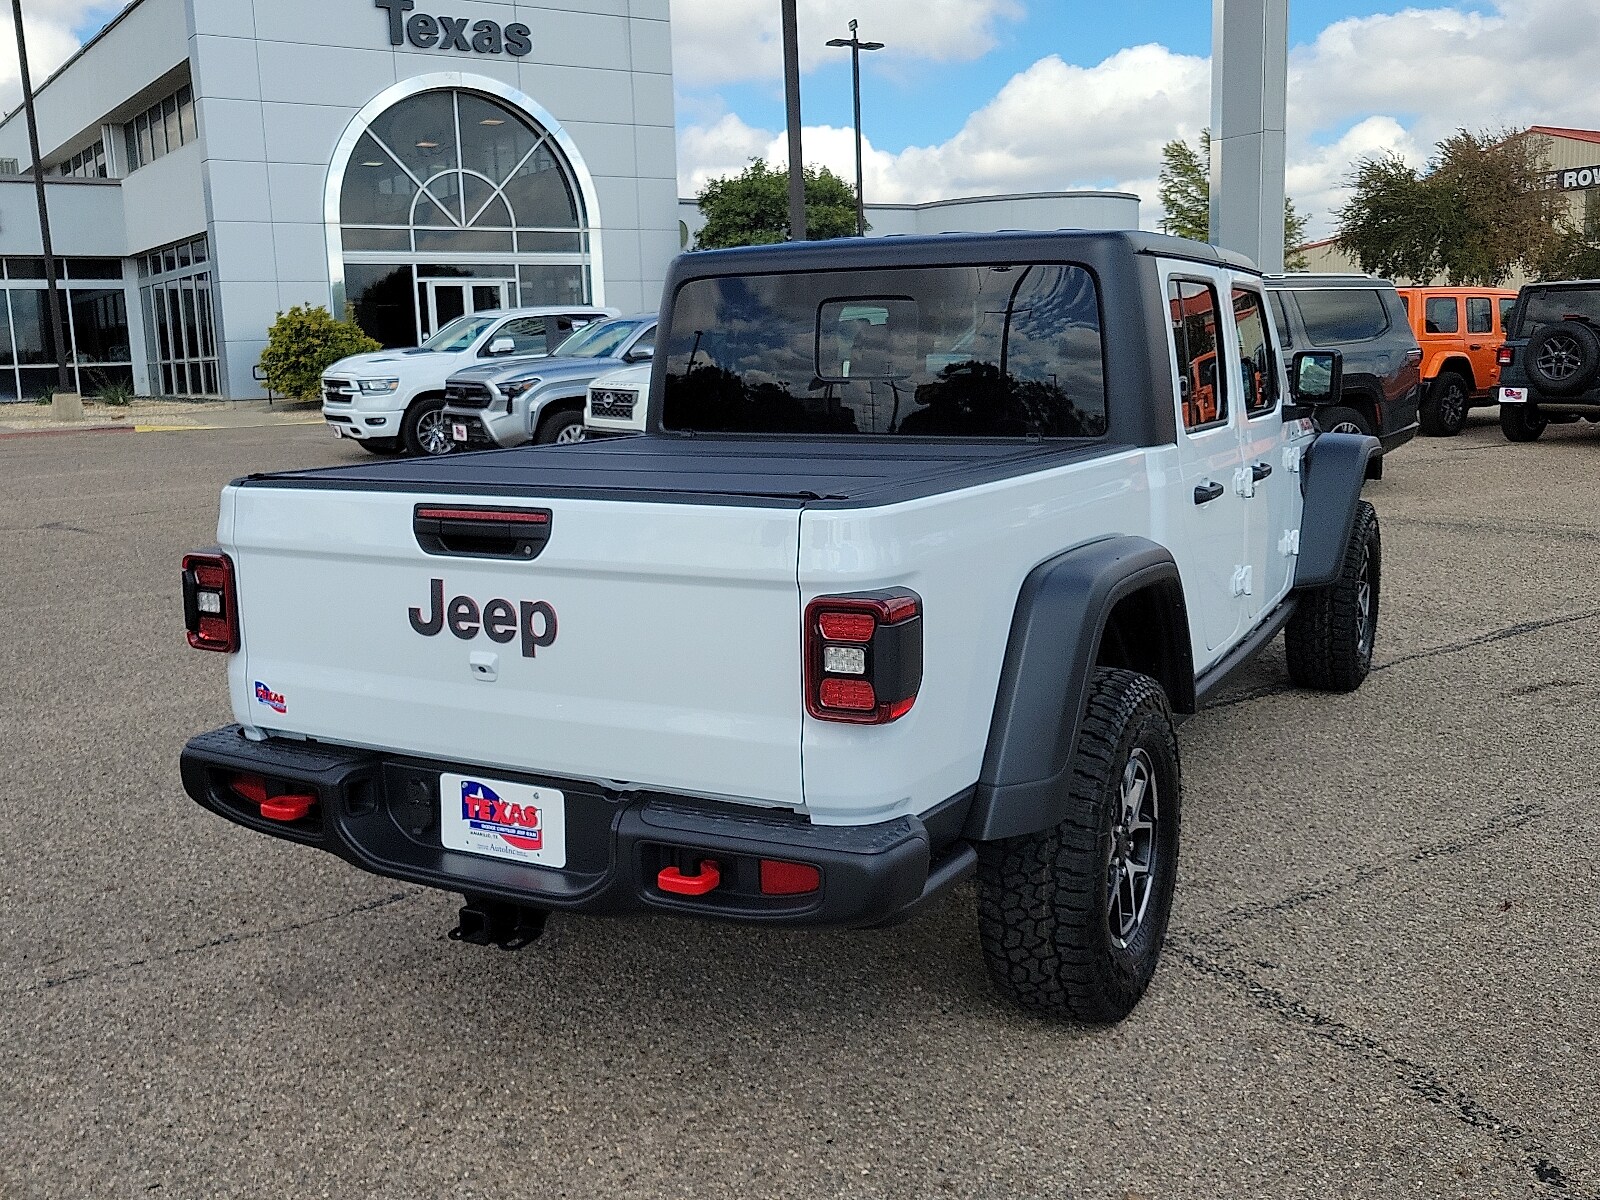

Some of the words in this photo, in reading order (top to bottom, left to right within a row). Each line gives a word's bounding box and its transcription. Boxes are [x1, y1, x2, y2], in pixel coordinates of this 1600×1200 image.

[375, 0, 533, 57] Texas
[408, 578, 559, 659] Jeep
[465, 795, 538, 829] TEXAS
